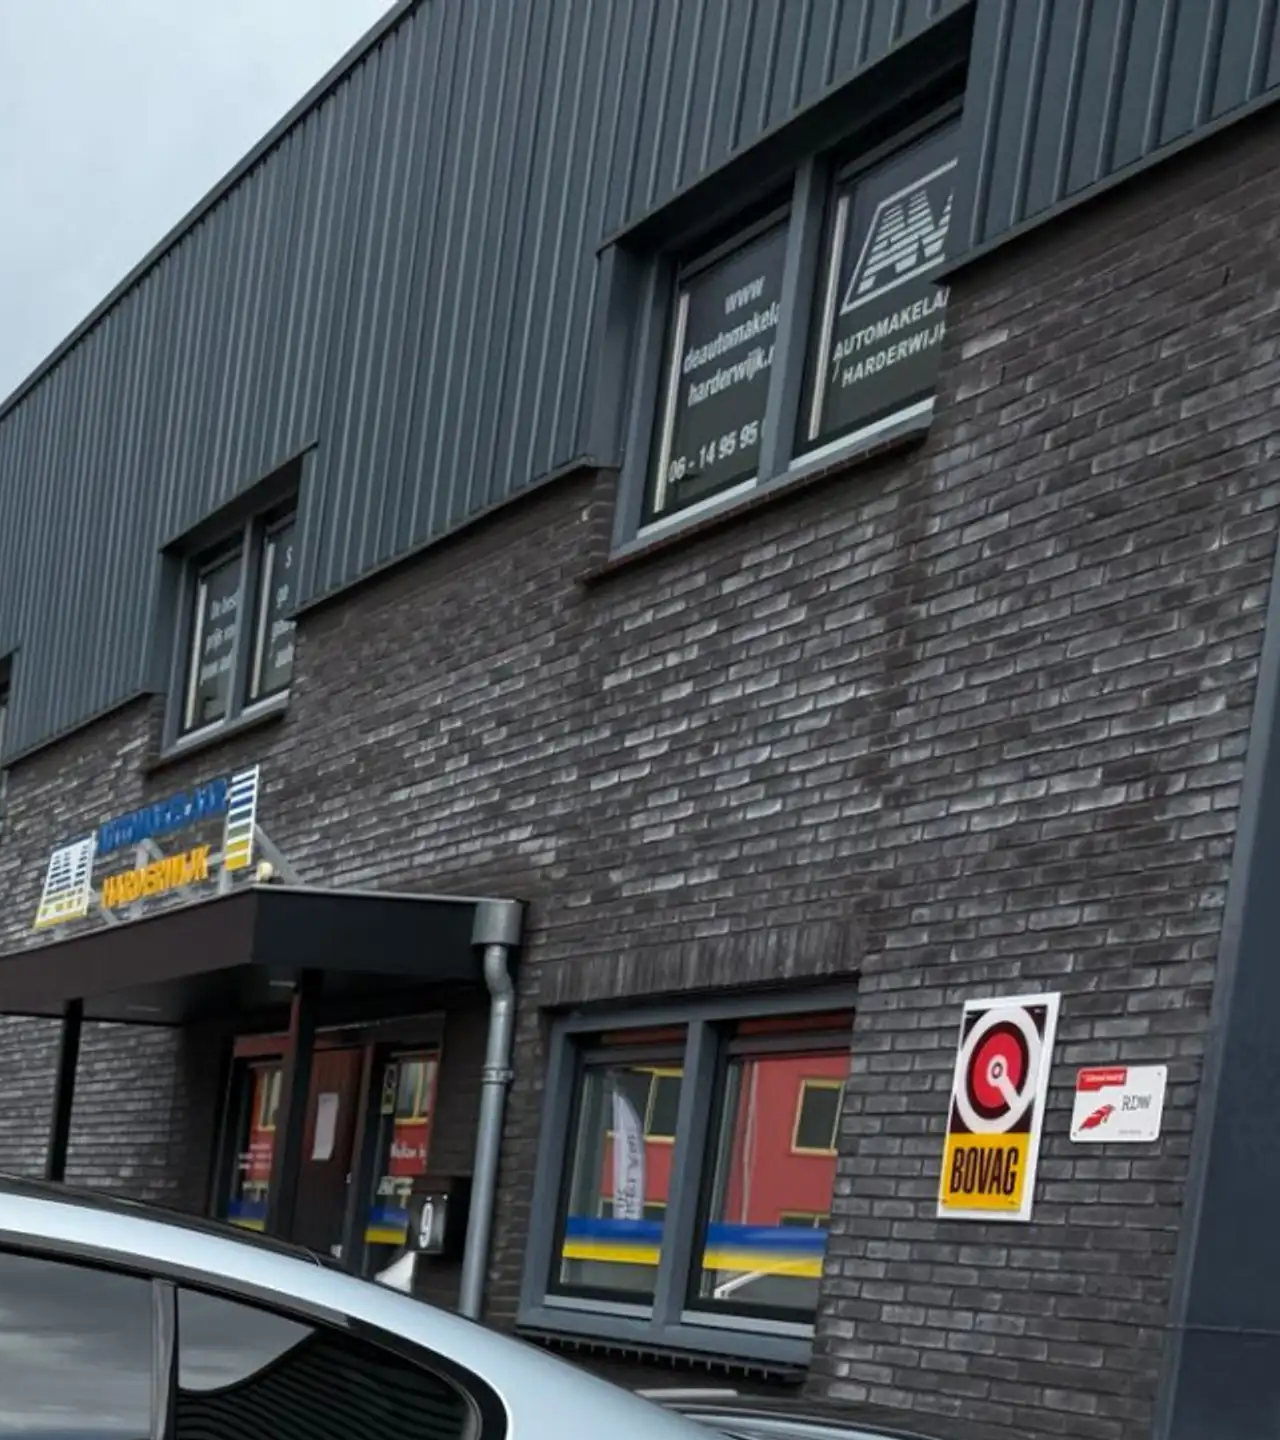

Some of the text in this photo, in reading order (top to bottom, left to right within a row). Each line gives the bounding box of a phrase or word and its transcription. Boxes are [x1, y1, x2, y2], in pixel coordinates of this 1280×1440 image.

[725, 276, 765, 314] www
[667, 456, 686, 483] 06
[699, 440, 717, 469] 14
[950, 1147, 1019, 1195] BOVAG
[419, 1202, 434, 1248] 9
